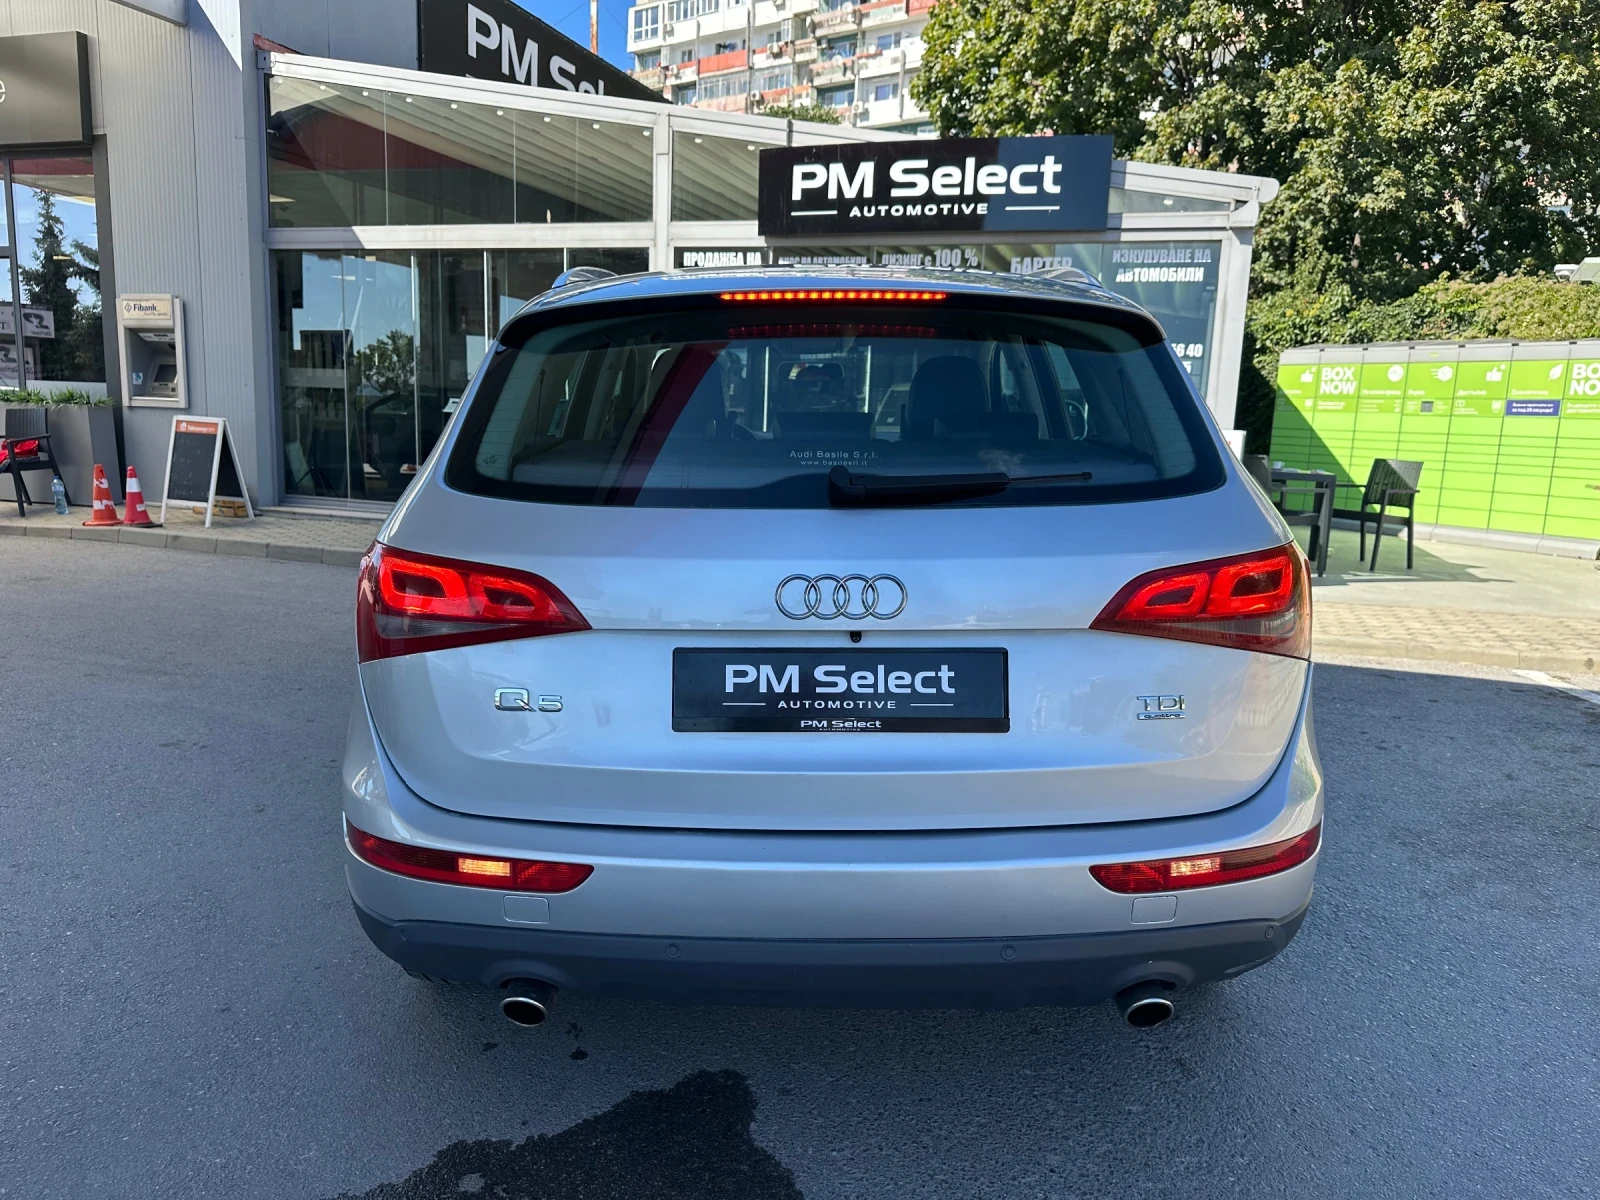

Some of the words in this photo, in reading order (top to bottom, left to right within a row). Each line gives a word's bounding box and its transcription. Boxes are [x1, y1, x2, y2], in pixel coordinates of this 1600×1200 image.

[467, 3, 538, 87] PM
[792, 160, 875, 200] PM
[889, 155, 1062, 198] Select
[850, 203, 988, 217] AUTOMOTIVE
[683, 251, 744, 267] ПРОДАЖБА
[746, 251, 762, 265] НА
[934, 248, 961, 267] 100
[964, 248, 978, 266] %
[1112, 248, 1192, 263] ИЗКУПУВАНЕ
[1194, 248, 1211, 263] НА
[1010, 257, 1072, 275] БАРТЕР
[1116, 267, 1204, 282] АВТОМОБИЛИ
[133, 303, 157, 312] Fibank
[1186, 342, 1203, 357] 40
[1321, 366, 1356, 380] BOX
[1320, 381, 1357, 395] NOW
[789, 450, 813, 458] Audi
[816, 450, 849, 458] Basile
[853, 450, 878, 458] S.r.l.
[725, 664, 800, 693] PM
[813, 664, 956, 693] Select
[494, 687, 563, 712] Q5
[777, 701, 897, 709] AUTOMOTIVE
[1137, 695, 1186, 711] TDI
[800, 720, 828, 728] PM
[831, 720, 882, 728] Select
